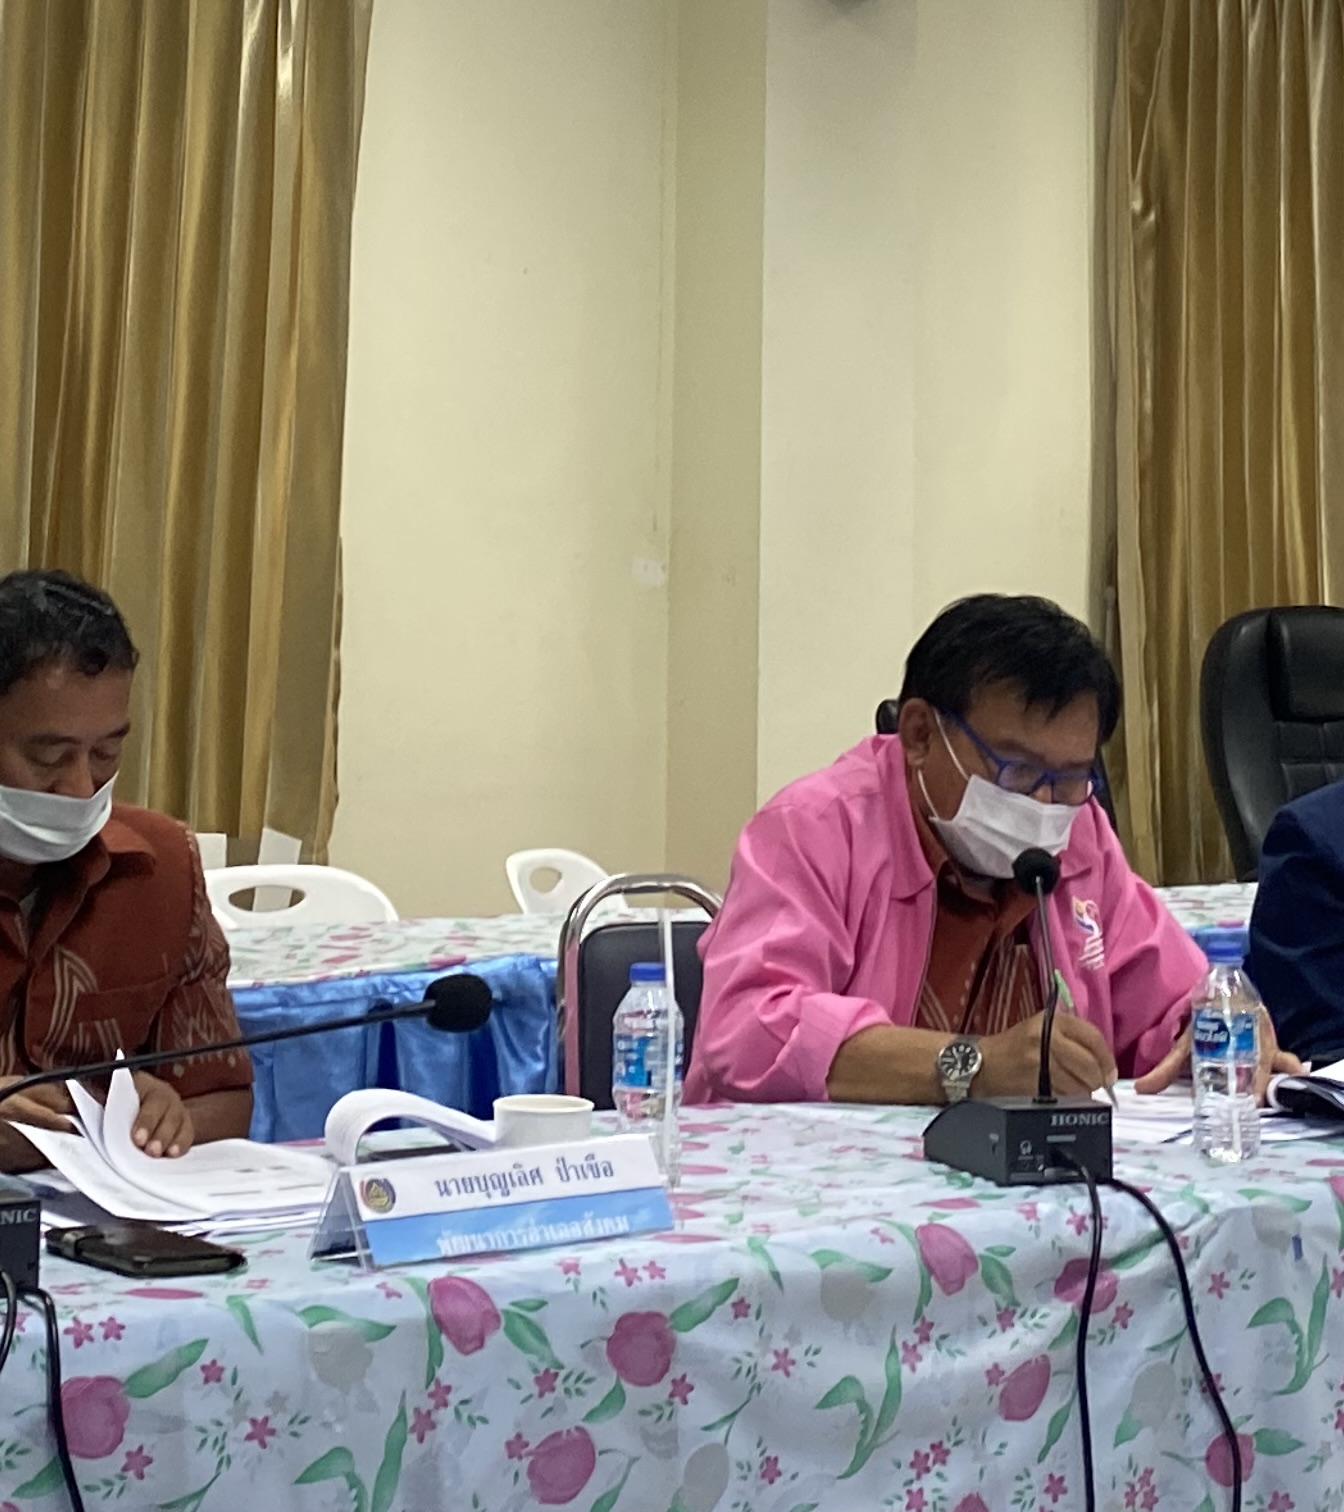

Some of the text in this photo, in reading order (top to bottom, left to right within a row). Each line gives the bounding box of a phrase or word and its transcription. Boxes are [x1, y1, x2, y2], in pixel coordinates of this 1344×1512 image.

[1050, 1112, 1110, 1127] HONIC
[434, 1162, 545, 1199] นายบุญเลิศ
